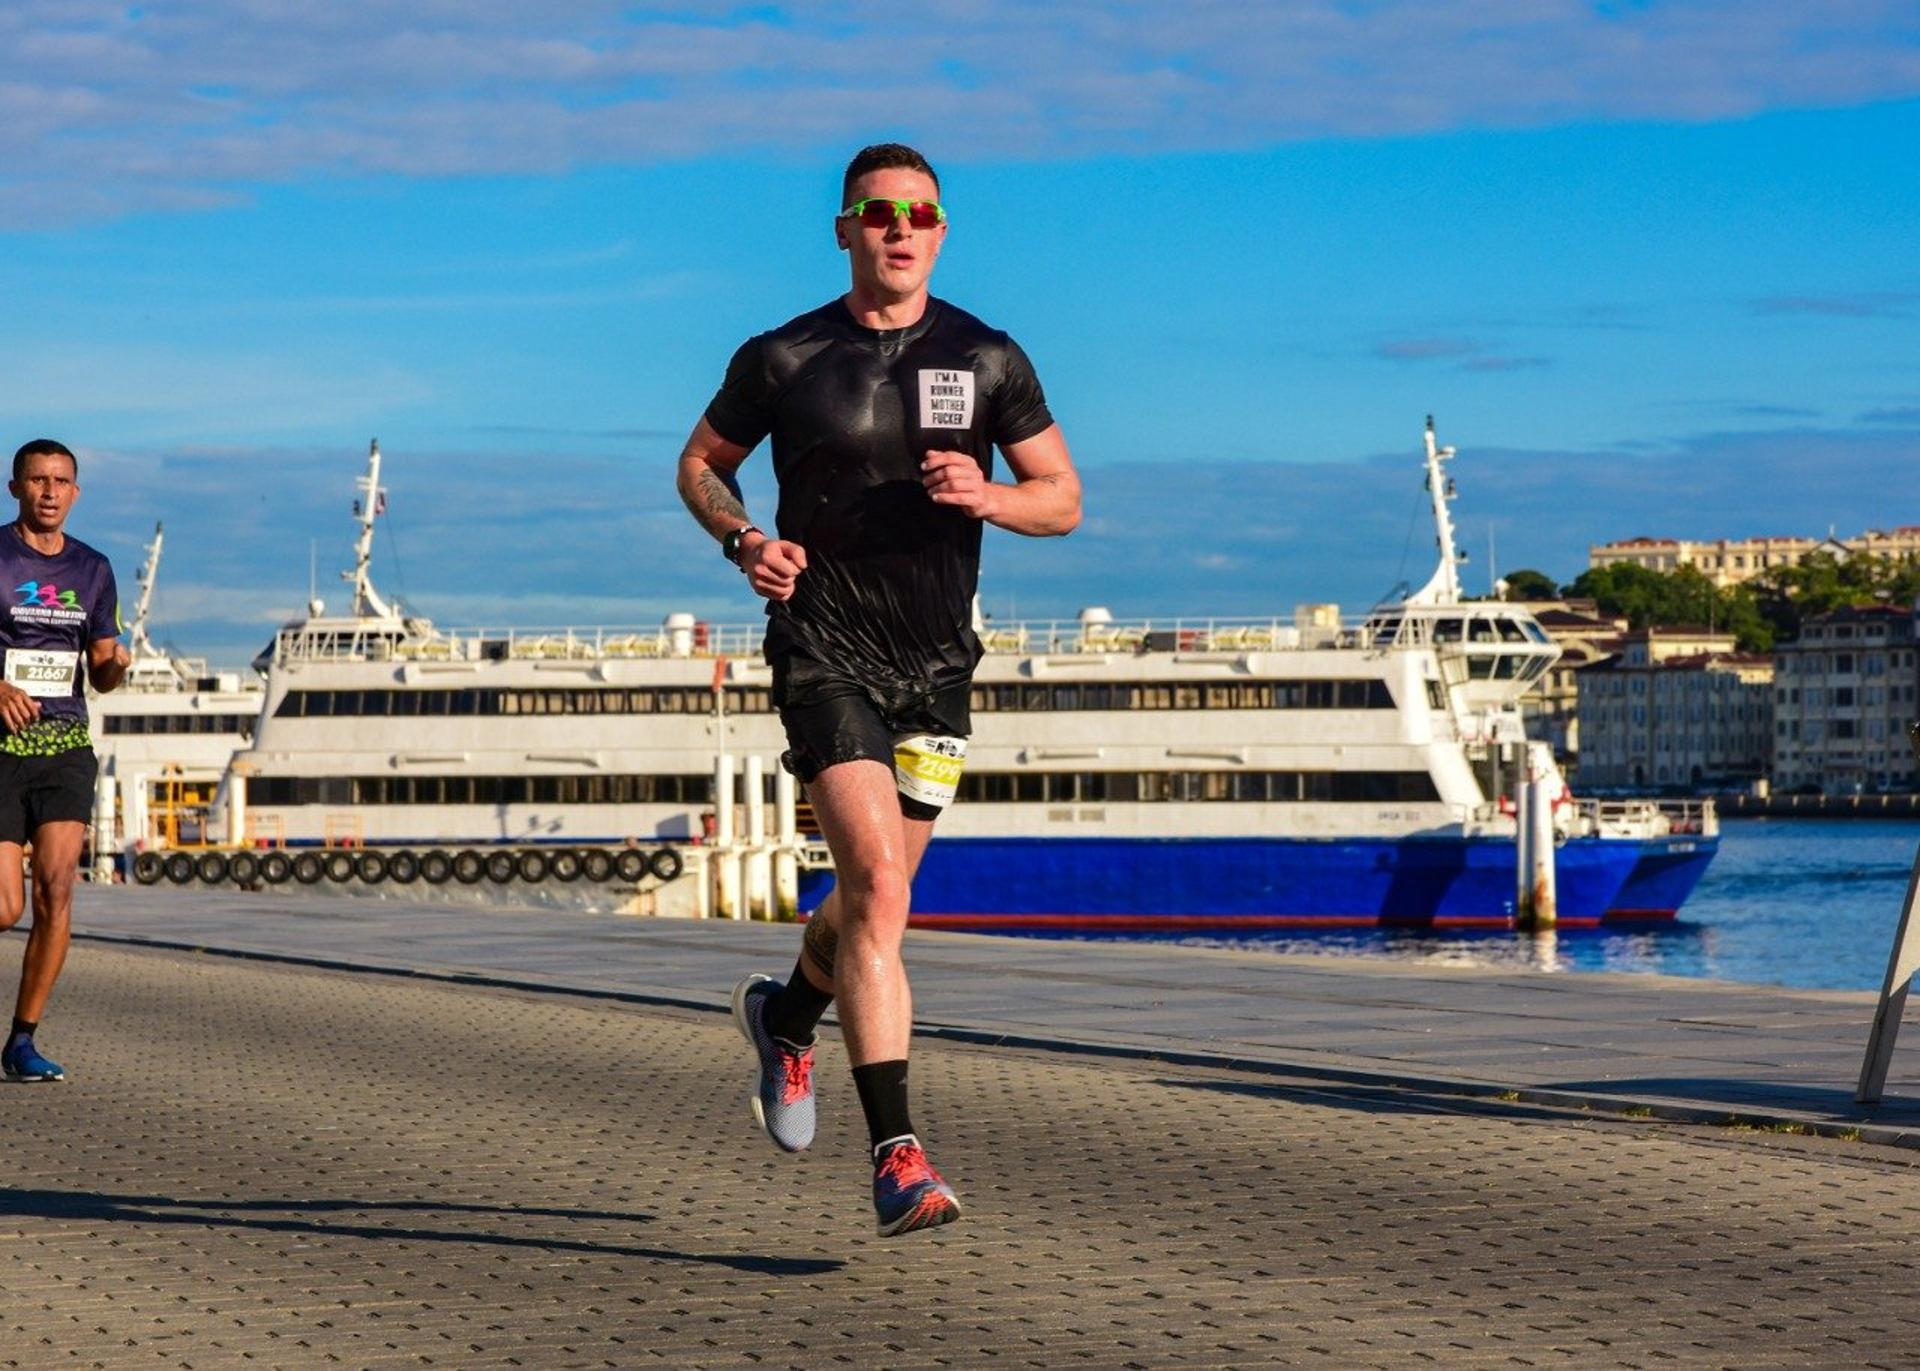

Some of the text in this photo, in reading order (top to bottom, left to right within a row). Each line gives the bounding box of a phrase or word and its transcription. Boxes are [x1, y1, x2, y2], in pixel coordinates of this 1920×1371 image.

[935, 372, 959, 383] I'M A
[930, 385, 964, 397] RUNNER
[931, 399, 965, 411] MOTHER
[932, 412, 963, 425] FUCKER
[27, 667, 67, 680] 21667
